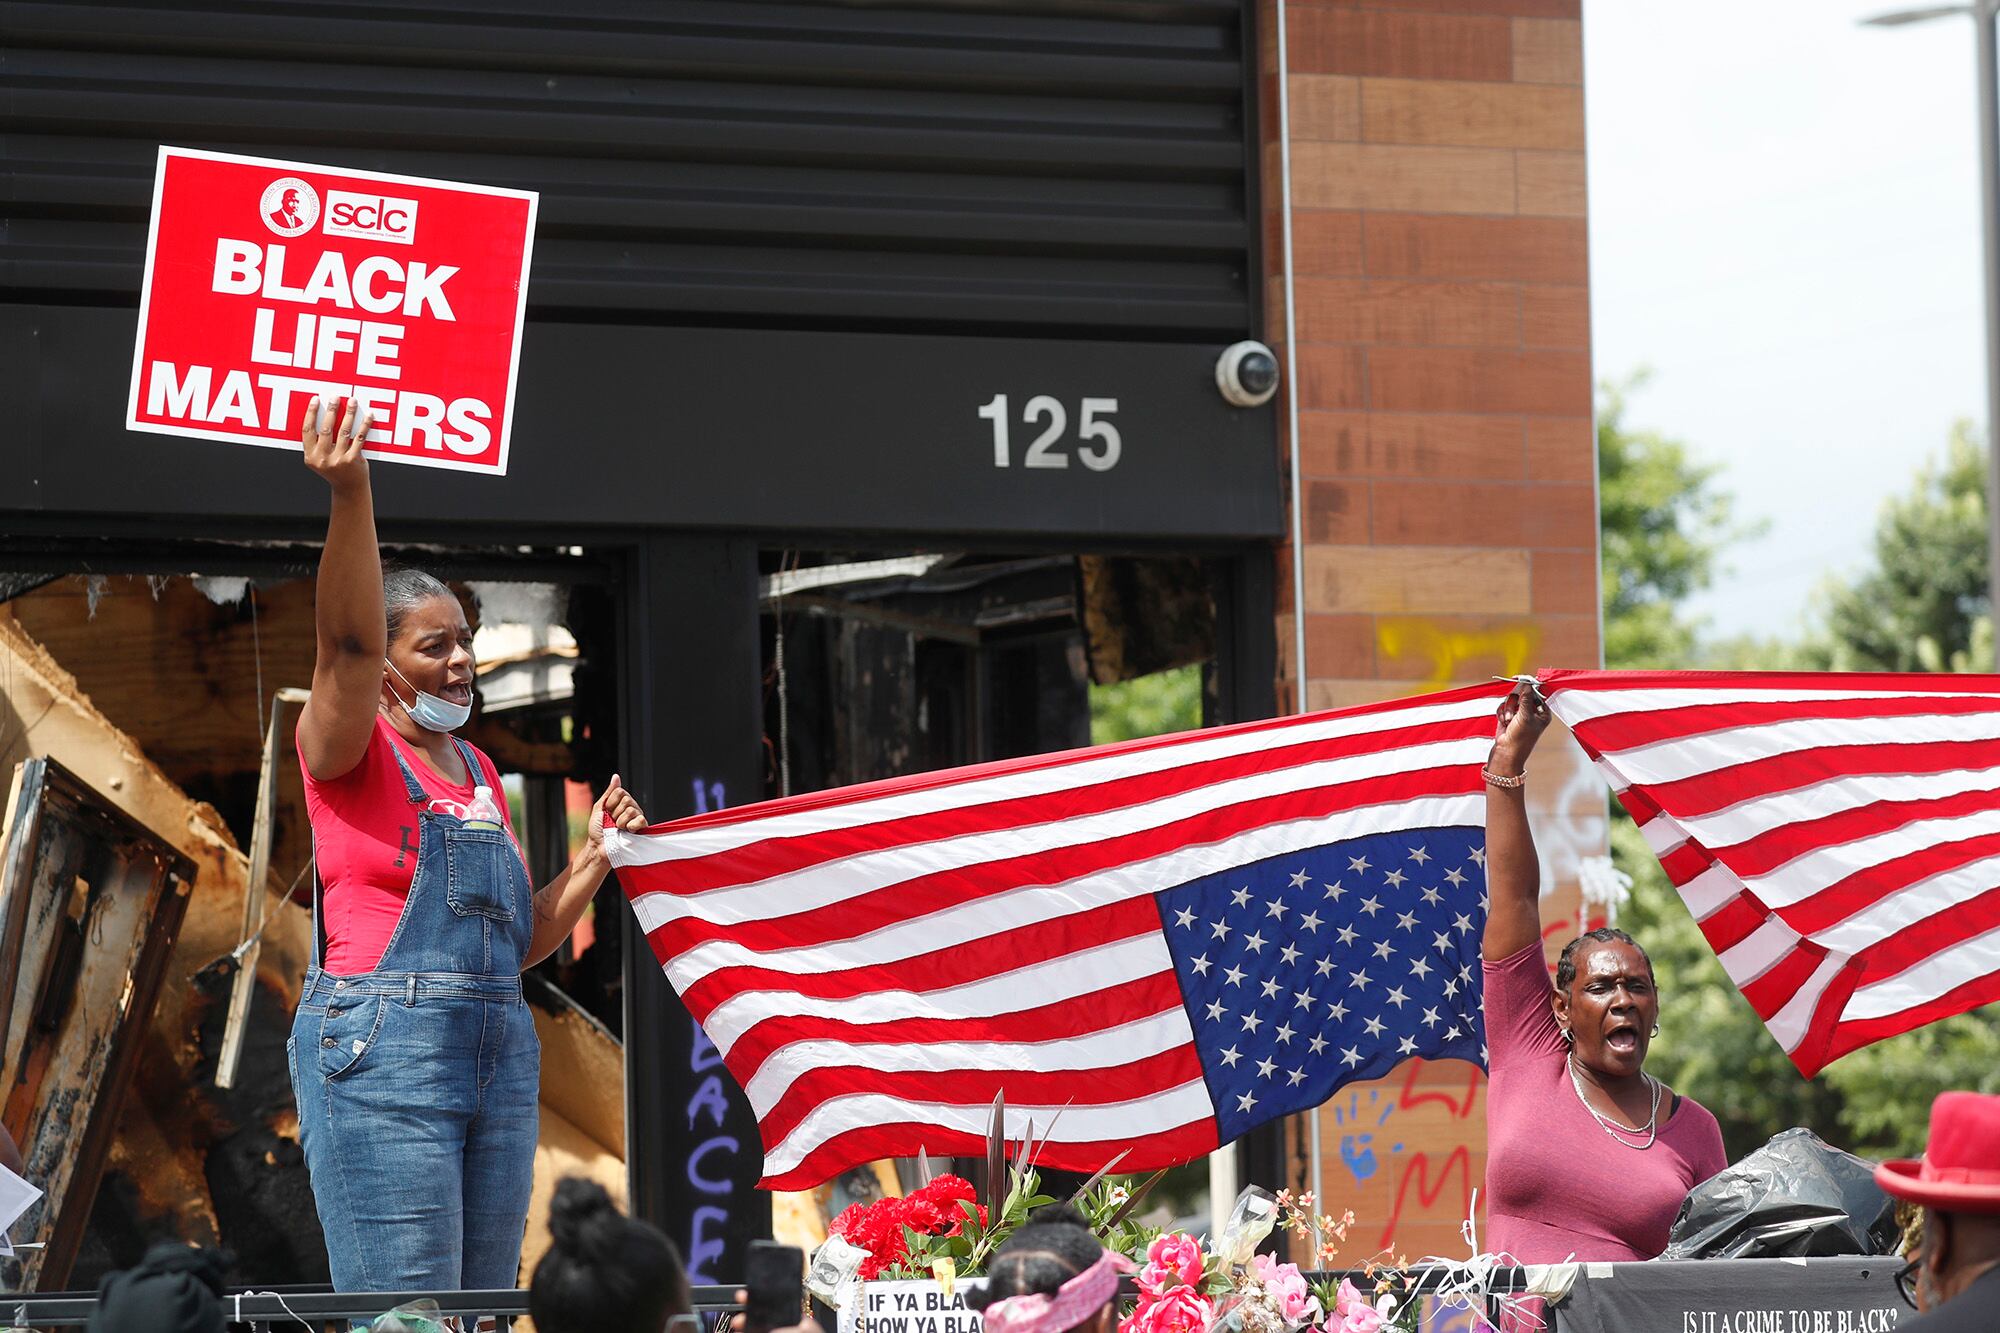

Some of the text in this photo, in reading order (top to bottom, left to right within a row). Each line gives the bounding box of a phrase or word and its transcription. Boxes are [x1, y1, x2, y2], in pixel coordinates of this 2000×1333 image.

[331, 199, 408, 233] sclc
[211, 237, 460, 321] BLACK
[250, 307, 405, 379] LIFE
[146, 360, 492, 455] MATTERS
[978, 394, 1122, 471] 125
[855, 1316, 984, 1333] SHOW YA BLA
[869, 1292, 965, 1312] IF YA BLA
[1683, 1308, 1898, 1333] IS IT A CRIME TO BE BLACK?
